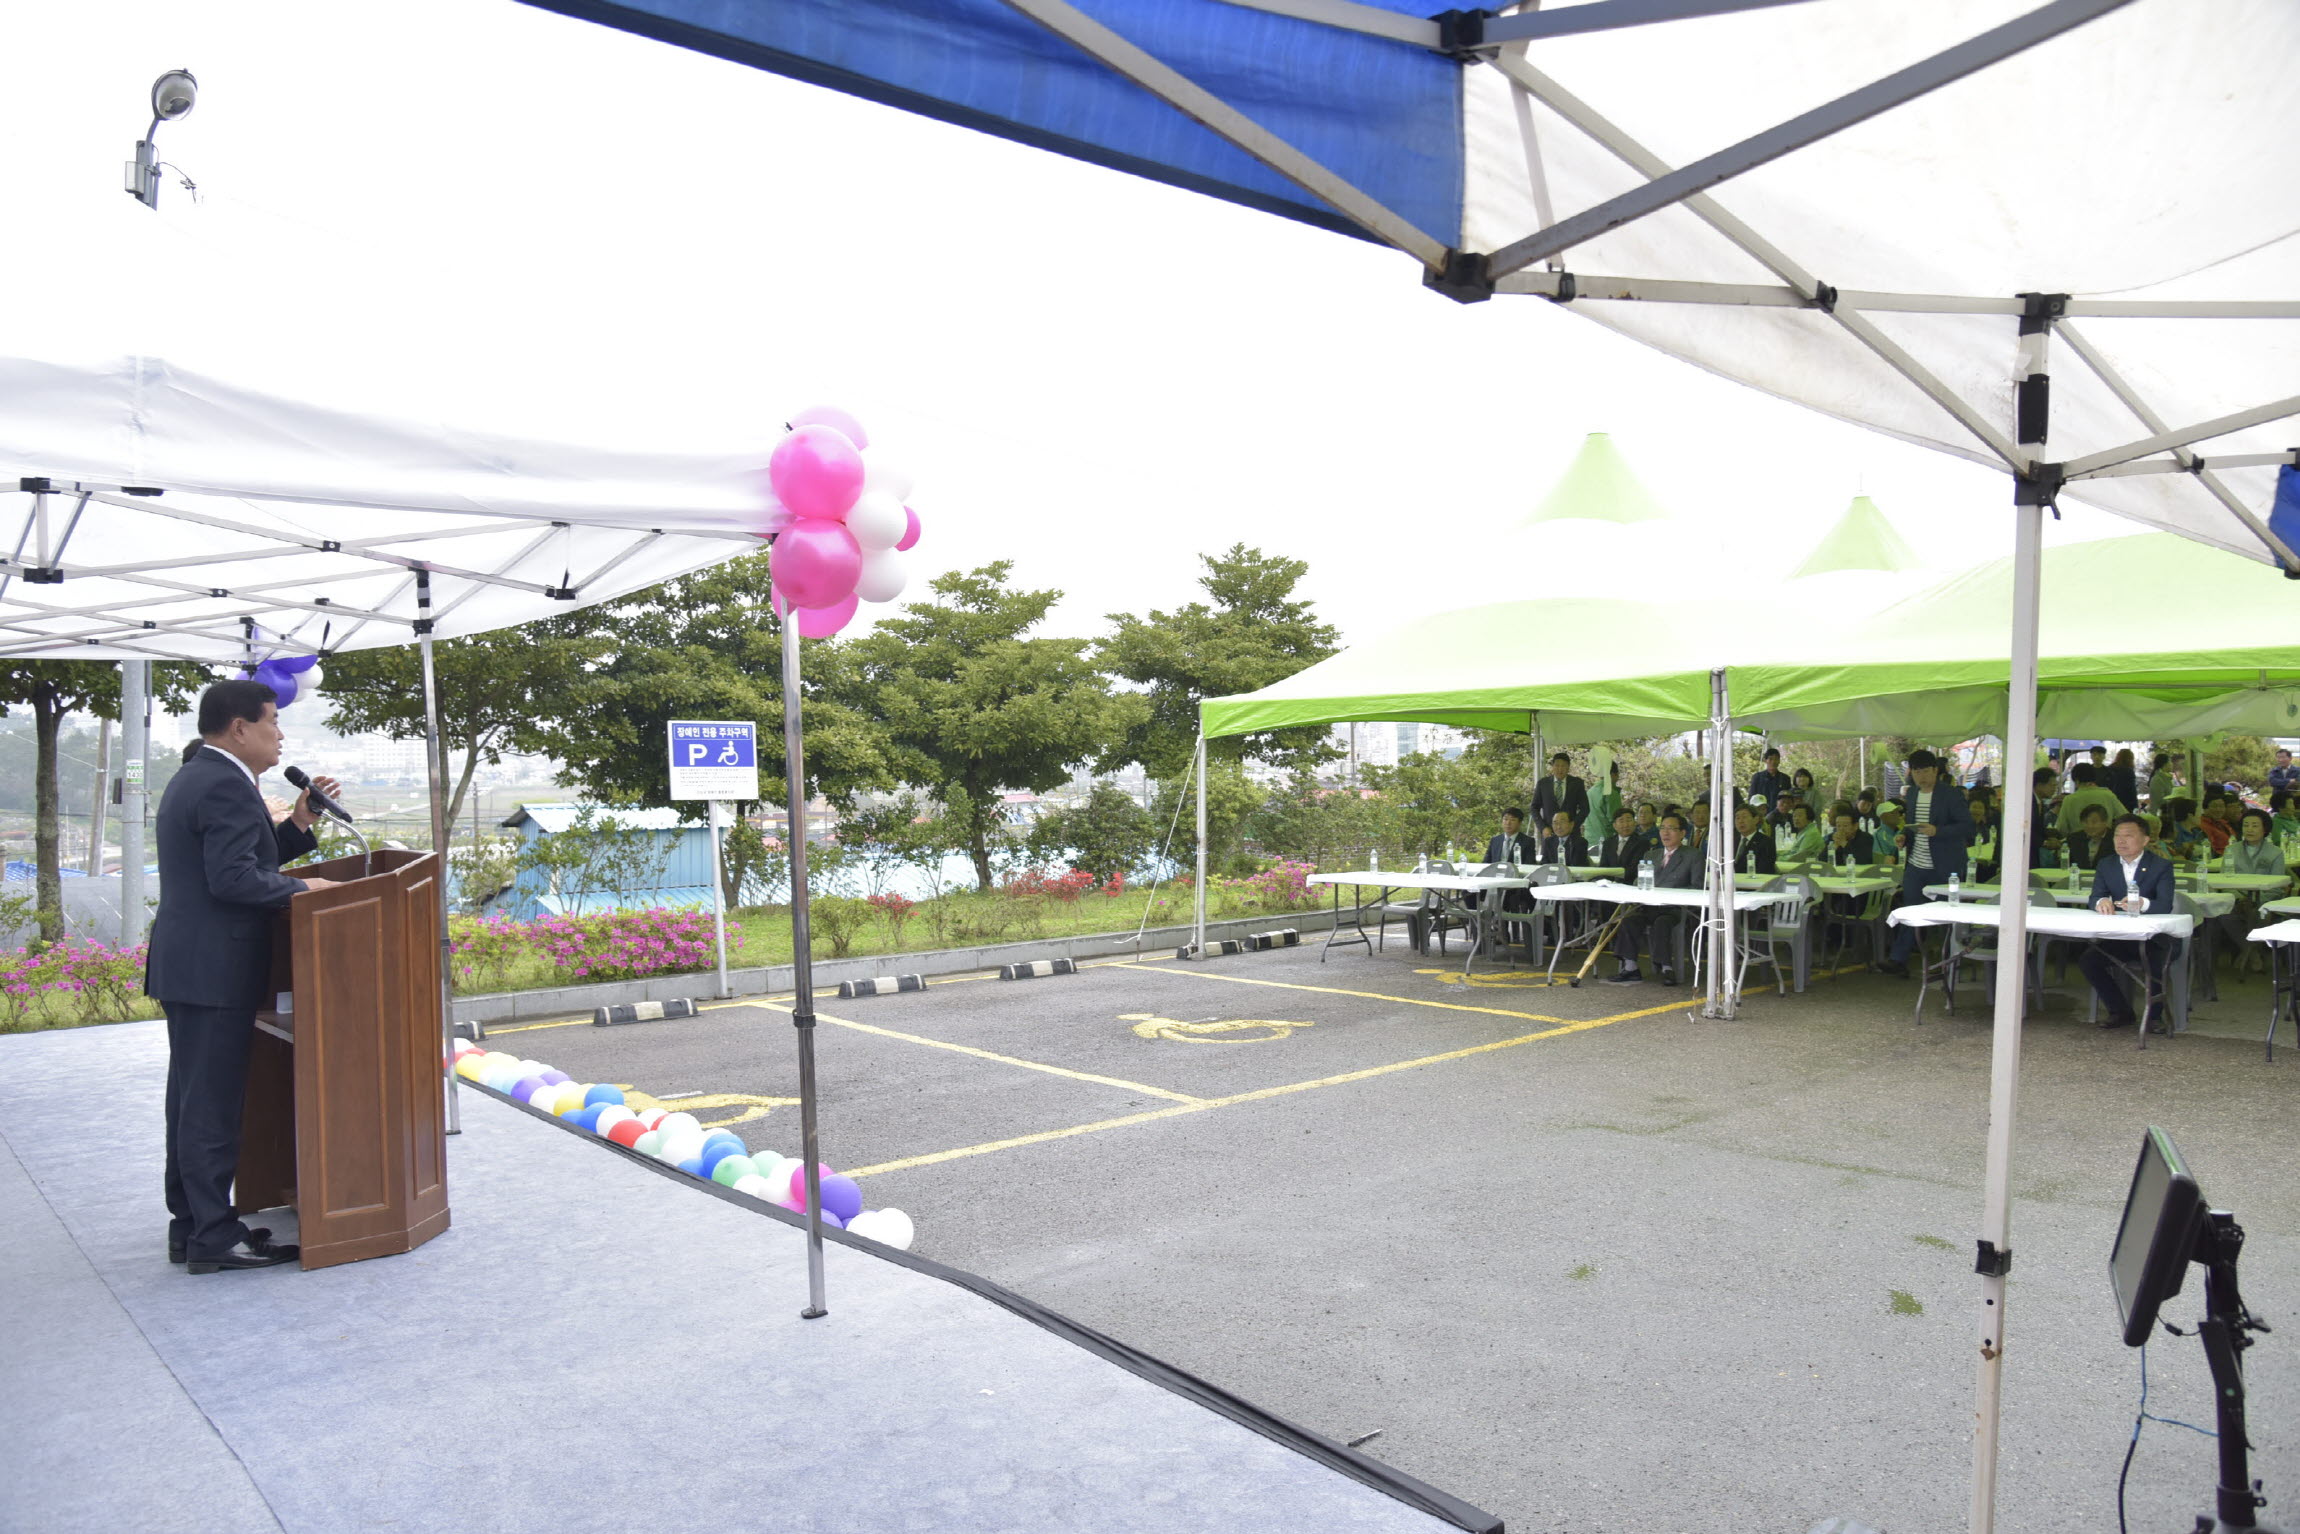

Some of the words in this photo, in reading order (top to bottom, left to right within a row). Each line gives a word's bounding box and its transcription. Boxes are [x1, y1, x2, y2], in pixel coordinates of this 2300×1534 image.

[677, 727, 700, 738] 장애인
[702, 727, 717, 738] 전용
[719, 727, 748, 739] 주차구역
[689, 744, 708, 766] P
